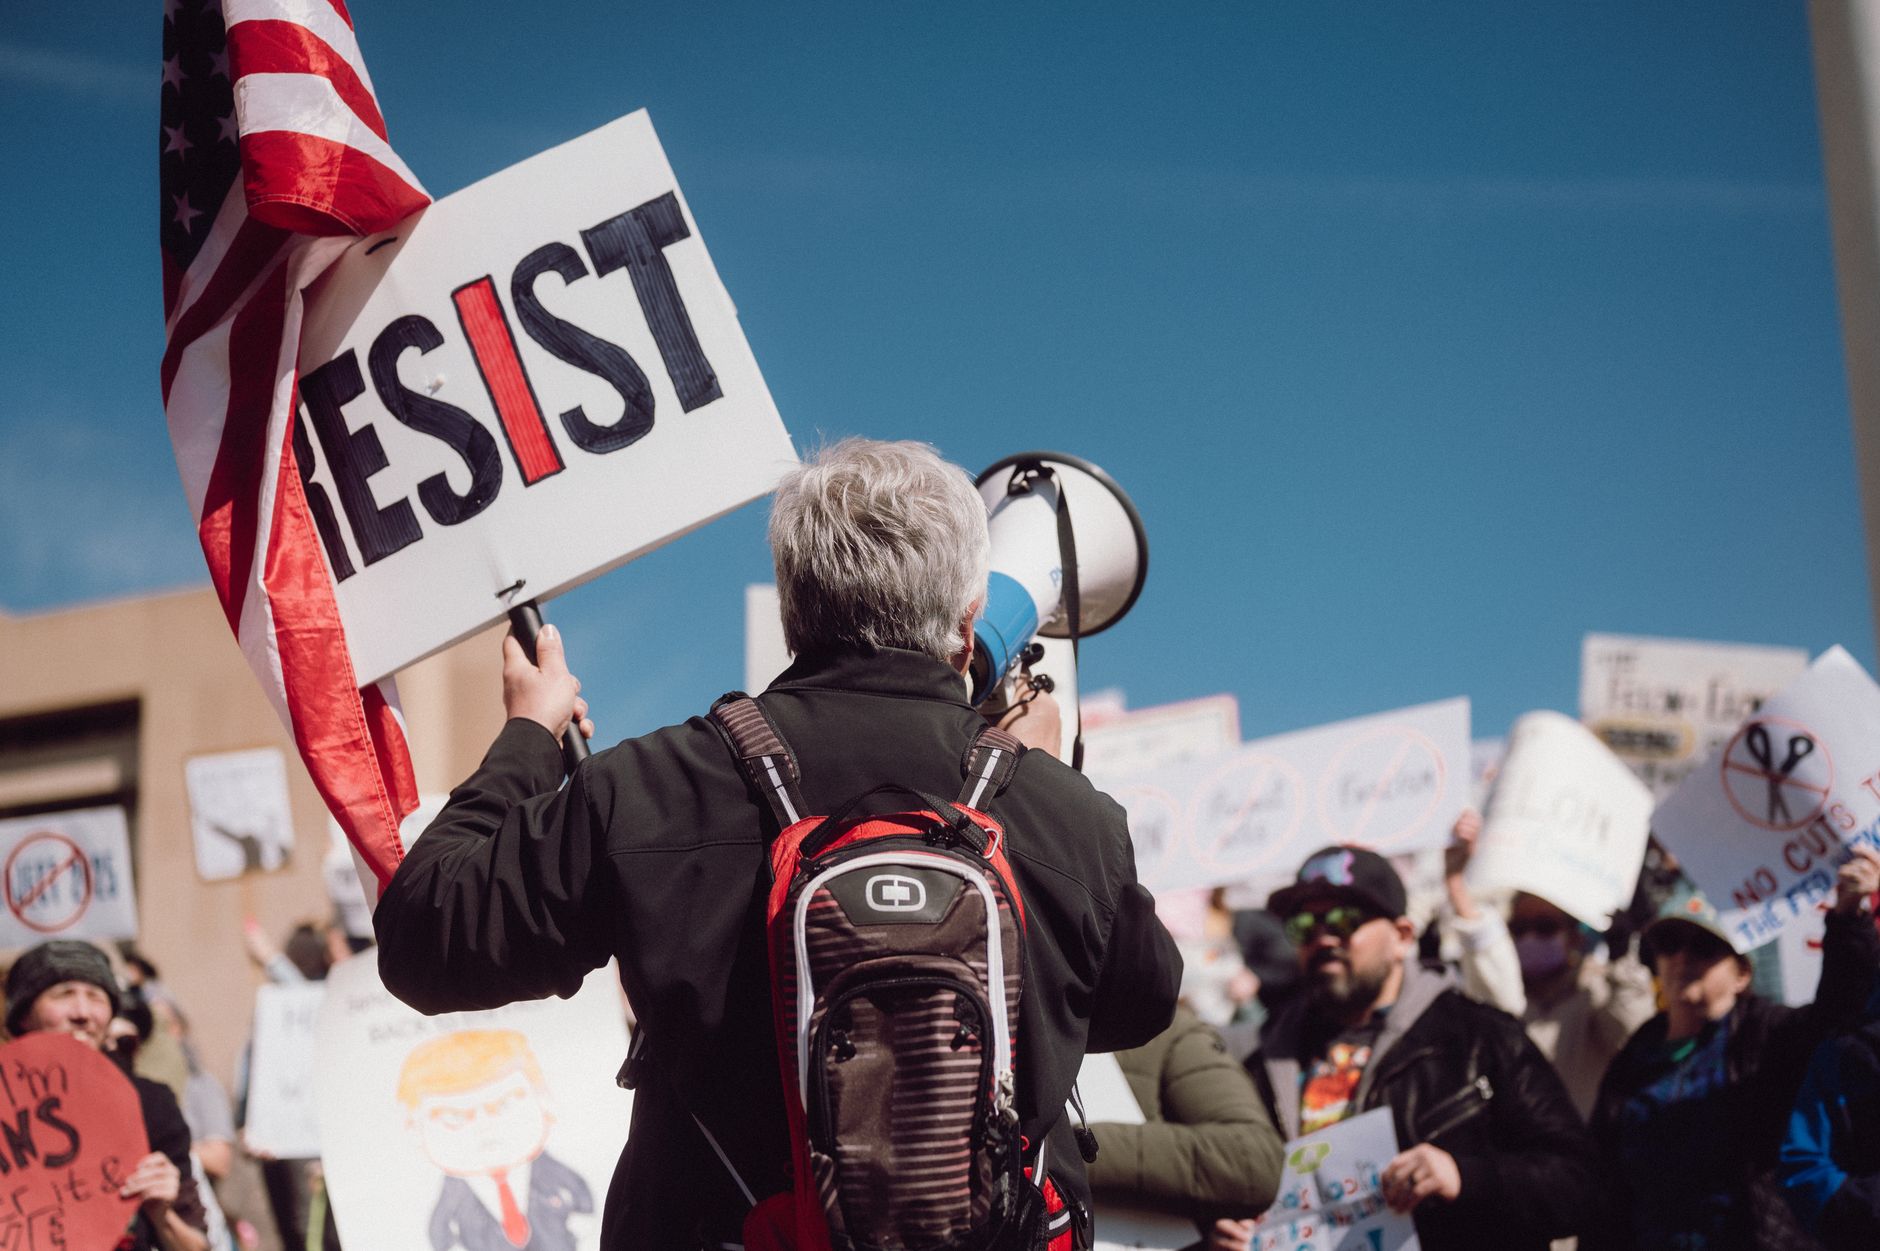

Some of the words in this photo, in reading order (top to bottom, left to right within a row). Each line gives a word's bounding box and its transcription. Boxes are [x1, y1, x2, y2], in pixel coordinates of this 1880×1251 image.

[1732, 867, 1778, 911] NO
[1783, 803, 1856, 873] CUTS
[1736, 901, 1783, 942] THE
[0, 1097, 80, 1174] NS
